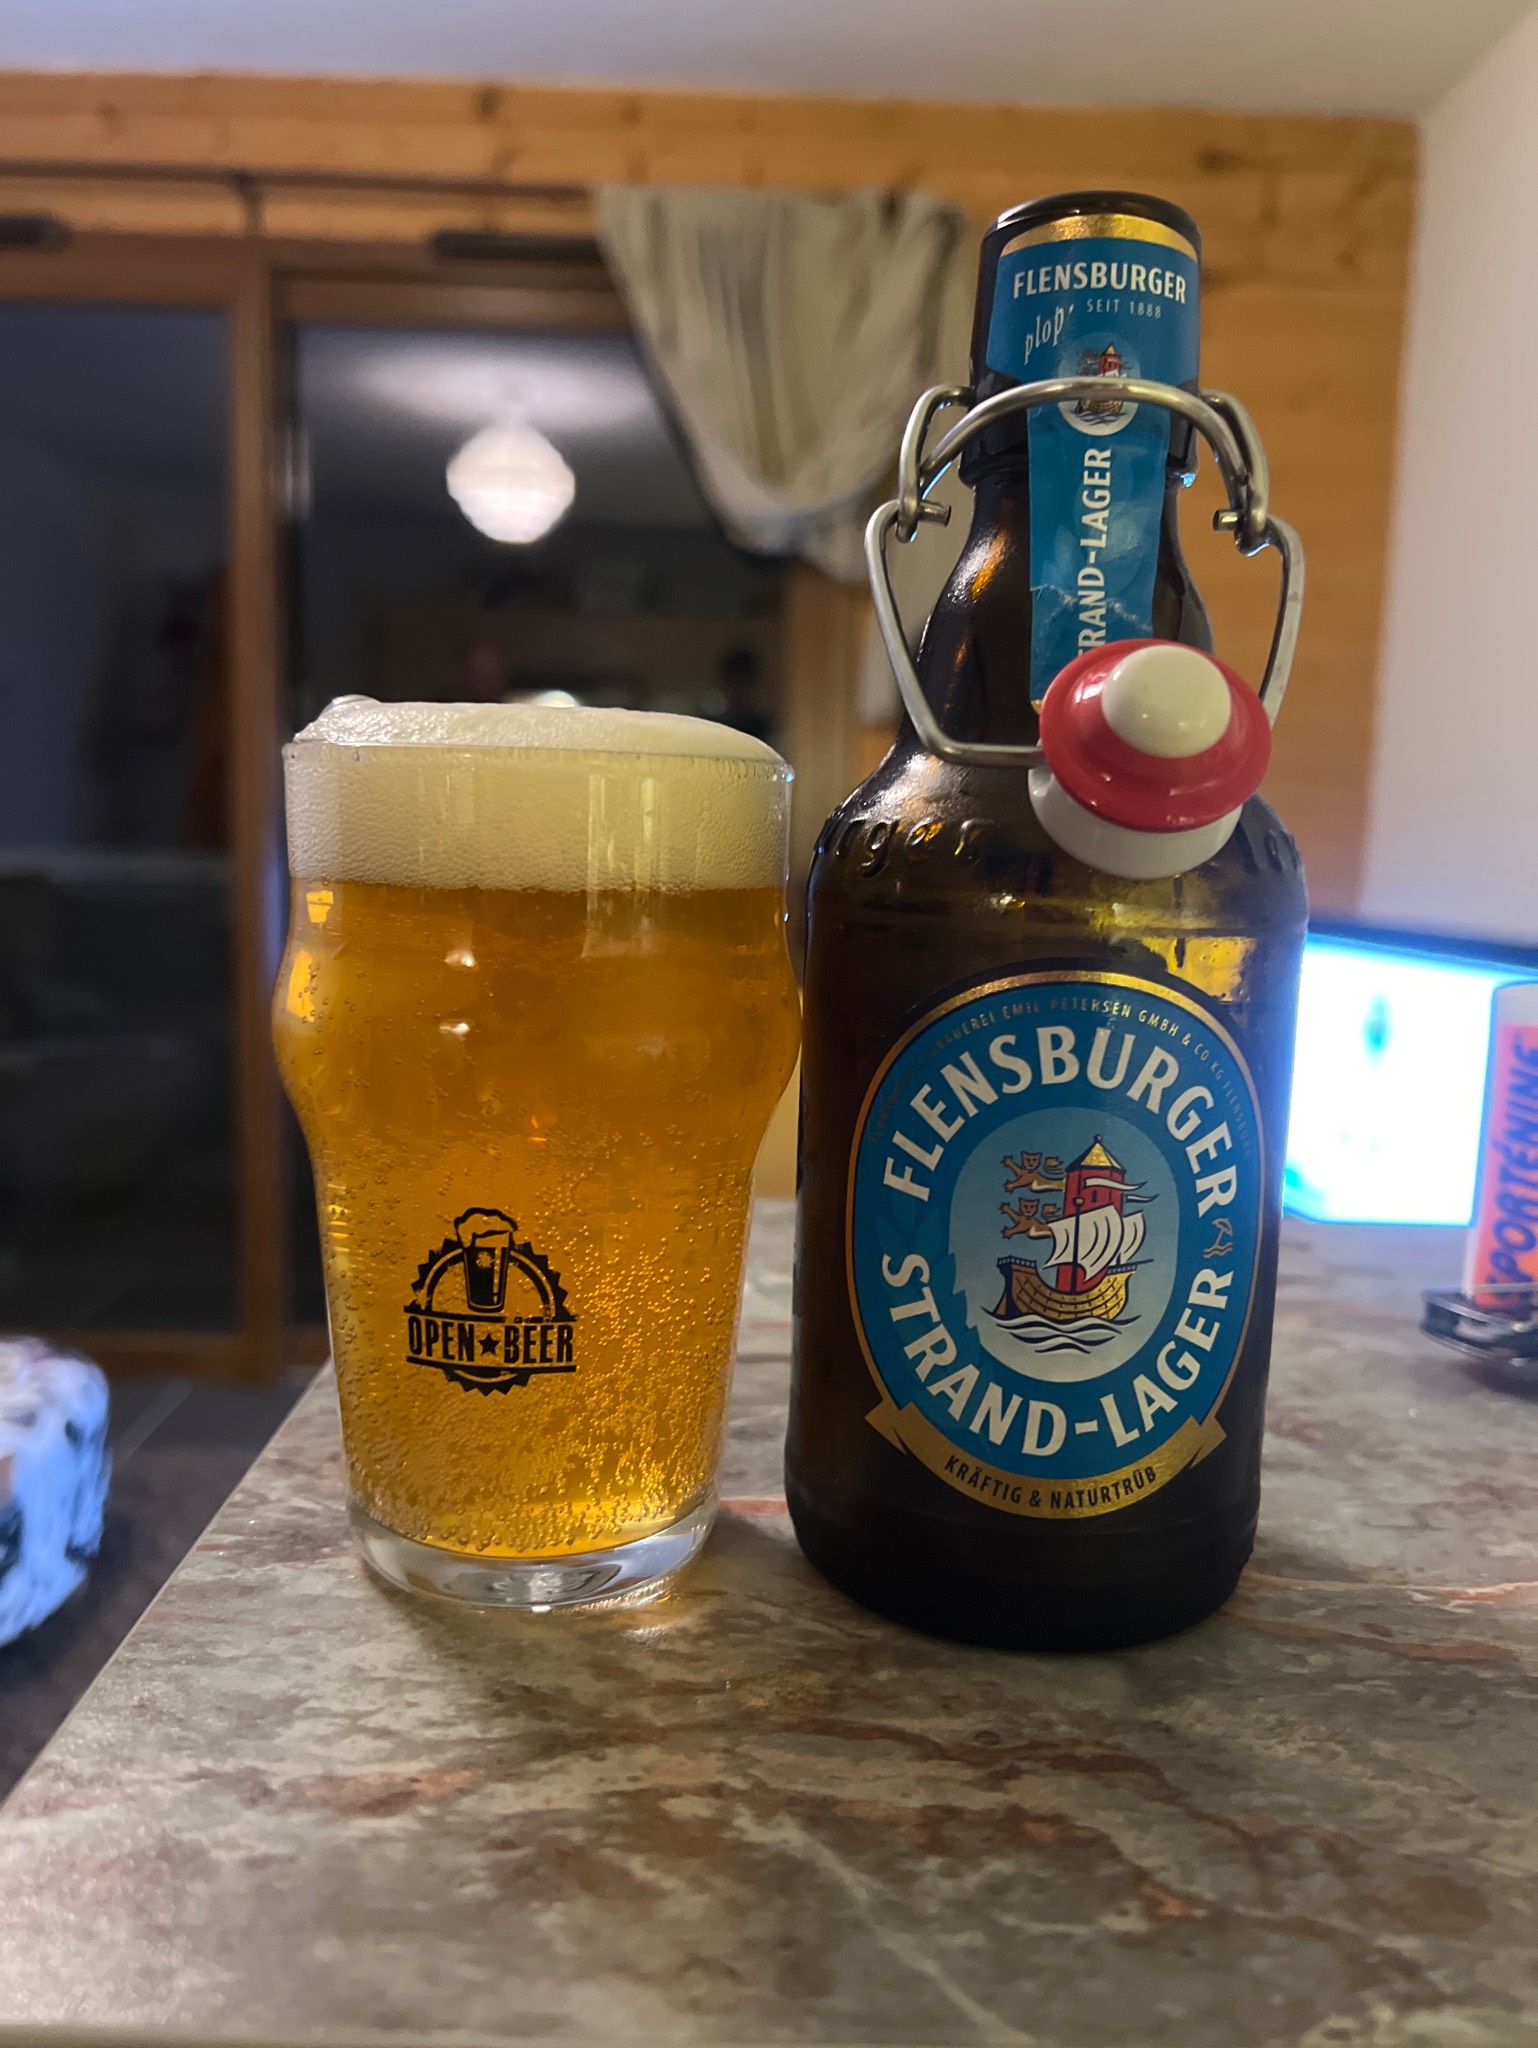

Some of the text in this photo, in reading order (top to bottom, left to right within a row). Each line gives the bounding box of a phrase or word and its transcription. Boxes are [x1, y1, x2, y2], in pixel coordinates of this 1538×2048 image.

[1013, 261, 1187, 304] FLENSBURGER
[1086, 298, 1163, 319] SEIT 1888
[1076, 447, 1111, 655] RAND-LAGER
[1002, 1001, 1041, 1020] EMIL
[1051, 996, 1132, 1018] PETERSEN
[1138, 1009, 1180, 1037] GMBH
[1181, 1033, 1192, 1047] &
[883, 1026, 1238, 1218] FLENSBURGER
[408, 1315, 575, 1365] OPEN BEER
[881, 1253, 1235, 1457] STRAND-LAGER
[944, 1455, 1158, 1510] KRÄFTIG & NATURTRÜB
